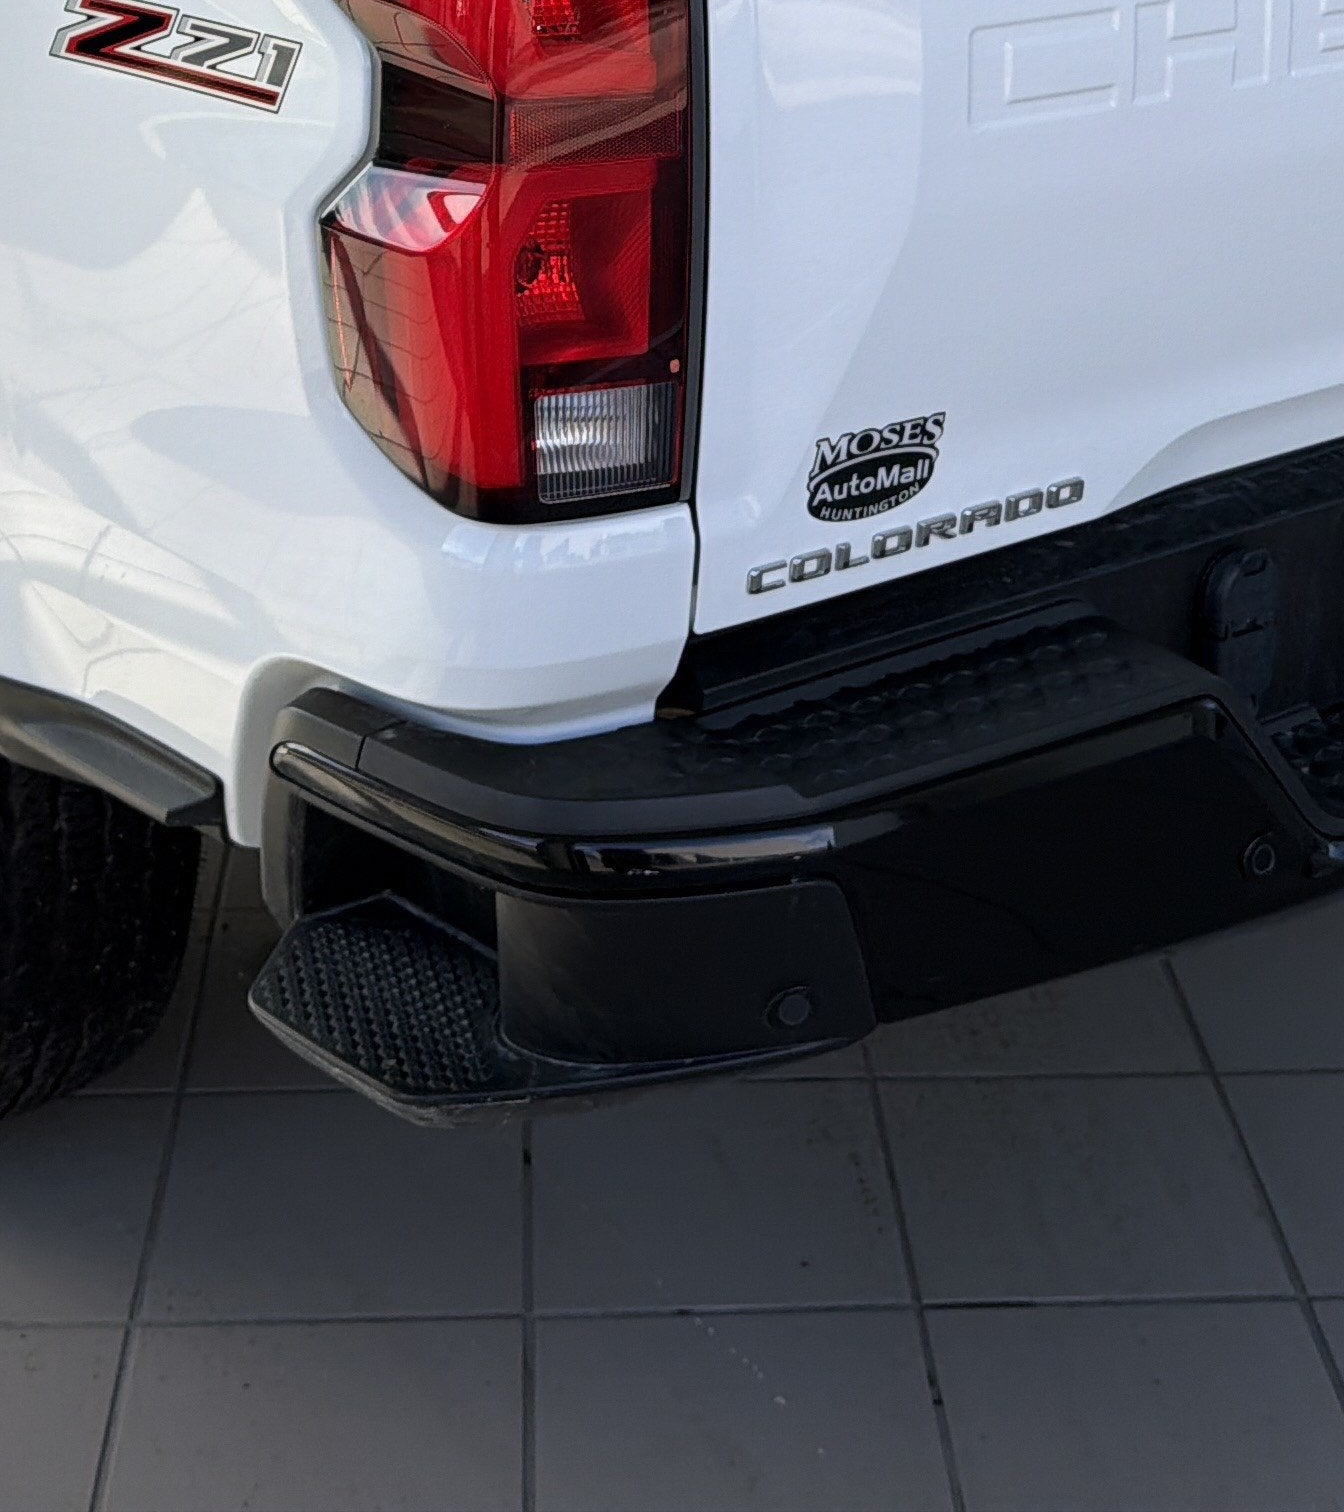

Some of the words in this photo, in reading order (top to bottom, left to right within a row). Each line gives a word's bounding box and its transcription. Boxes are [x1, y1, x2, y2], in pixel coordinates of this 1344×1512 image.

[809, 411, 946, 478] MOSES
[811, 458, 931, 507] AutoMall
[819, 481, 921, 521] HUNTINGTON
[746, 476, 1086, 595] COLORADO
